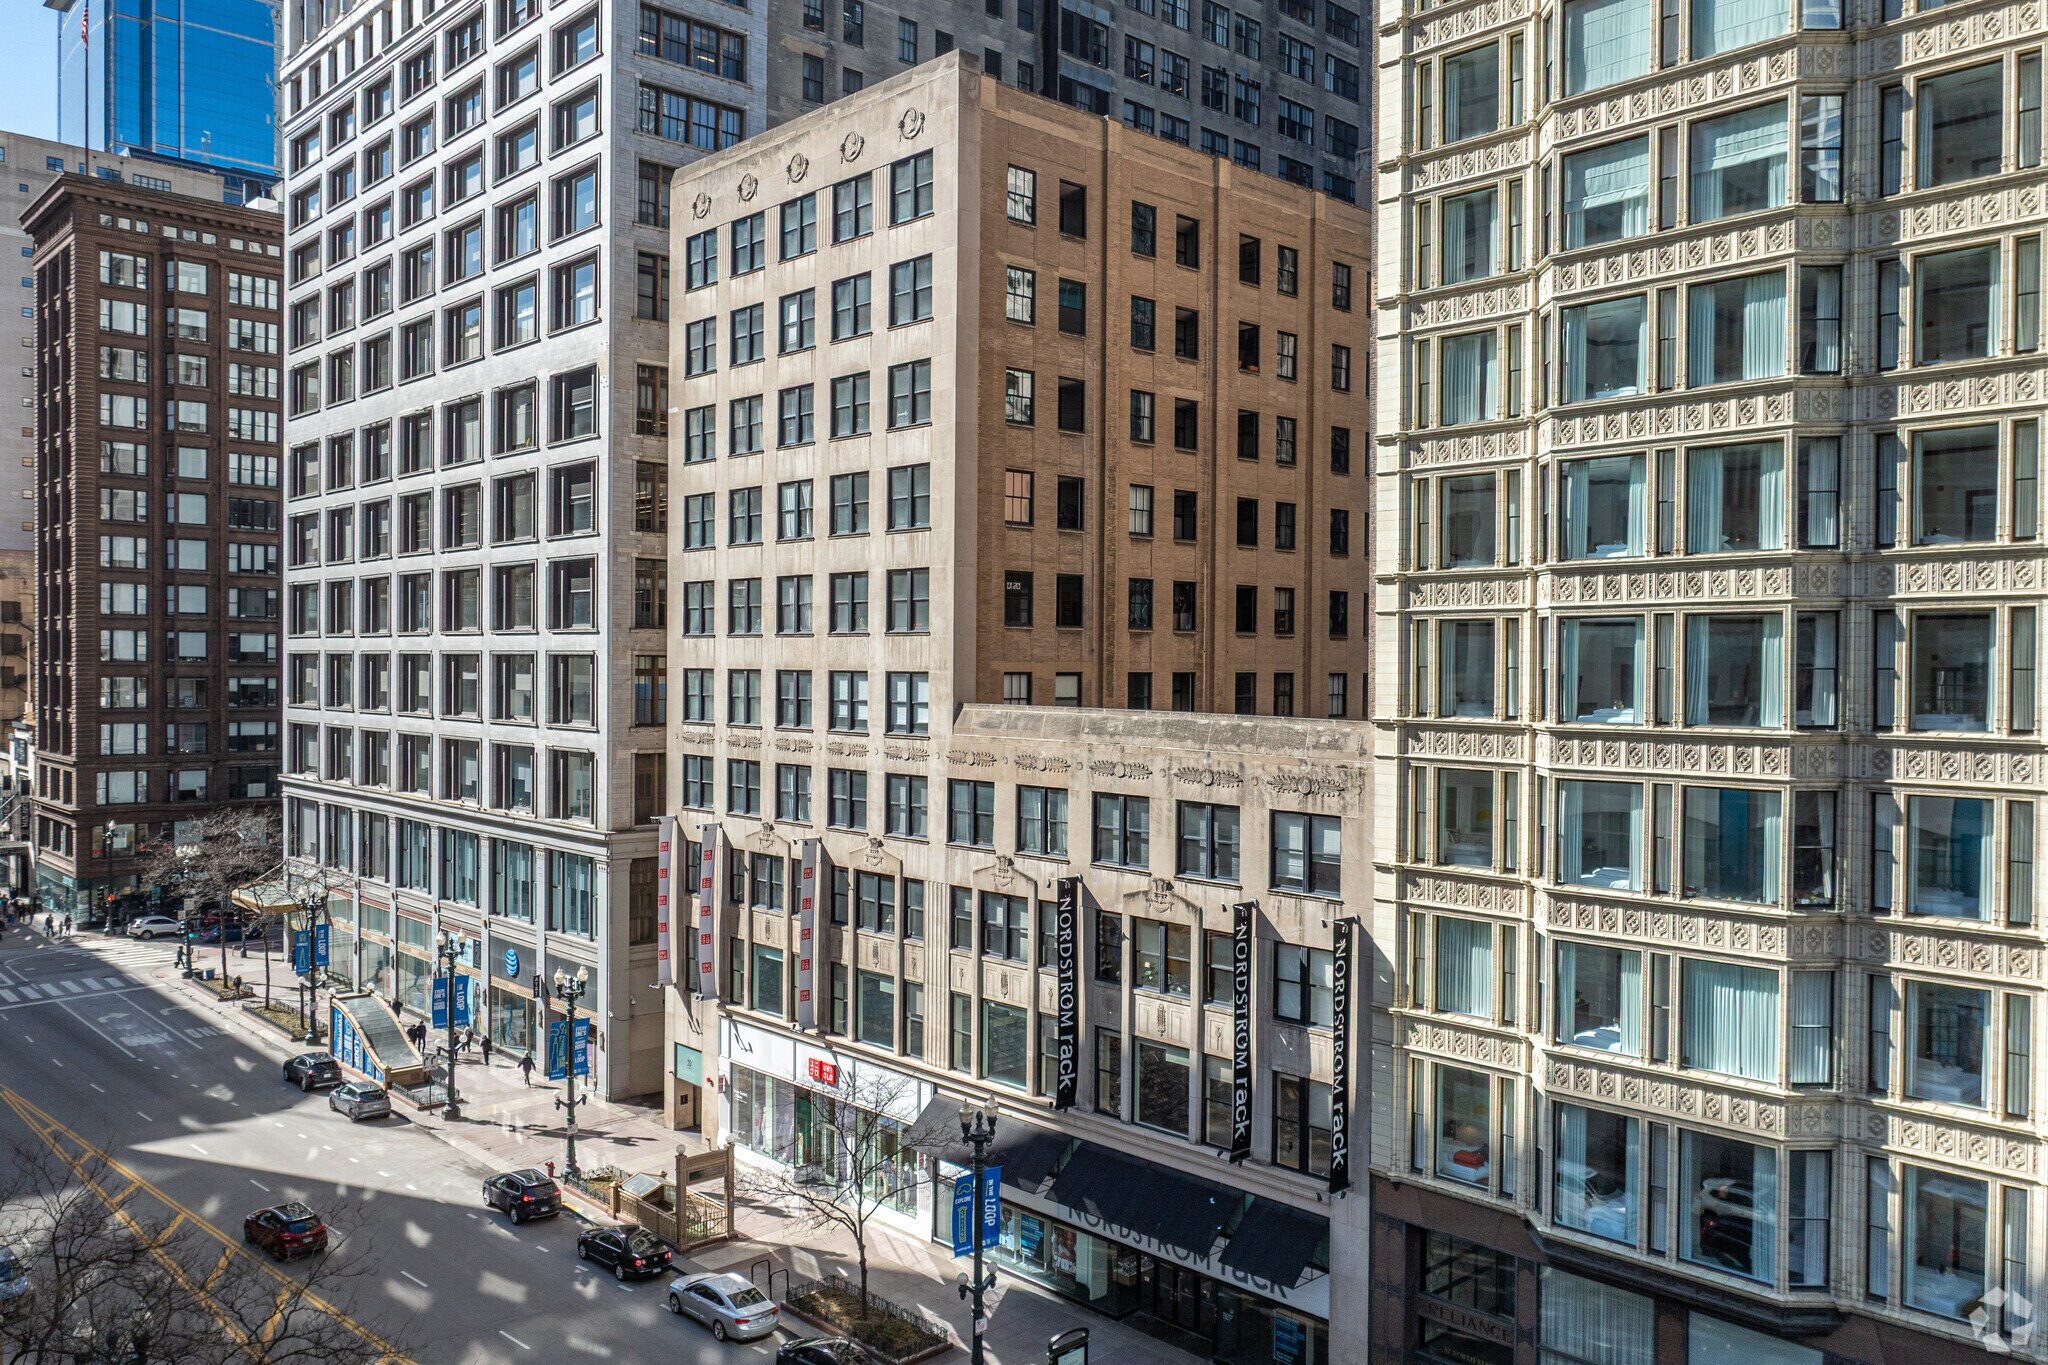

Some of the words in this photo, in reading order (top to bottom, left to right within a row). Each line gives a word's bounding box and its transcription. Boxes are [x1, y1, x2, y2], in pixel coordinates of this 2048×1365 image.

[1059, 898, 1074, 1028] NORDSTROM
[457, 992, 465, 1010] LOOP
[1235, 923, 1248, 1070] NORDSTROM
[1334, 943, 1346, 1094] NORDSTROM
[823, 1072, 833, 1081] QLO
[1059, 1034, 1076, 1090] rack
[1234, 1077, 1250, 1140] rack
[1332, 1102, 1347, 1170] rack
[955, 1196, 971, 1204] EXPLORE
[985, 1198, 996, 1226] LOOP
[1427, 1302, 1514, 1343] RELIANCE
